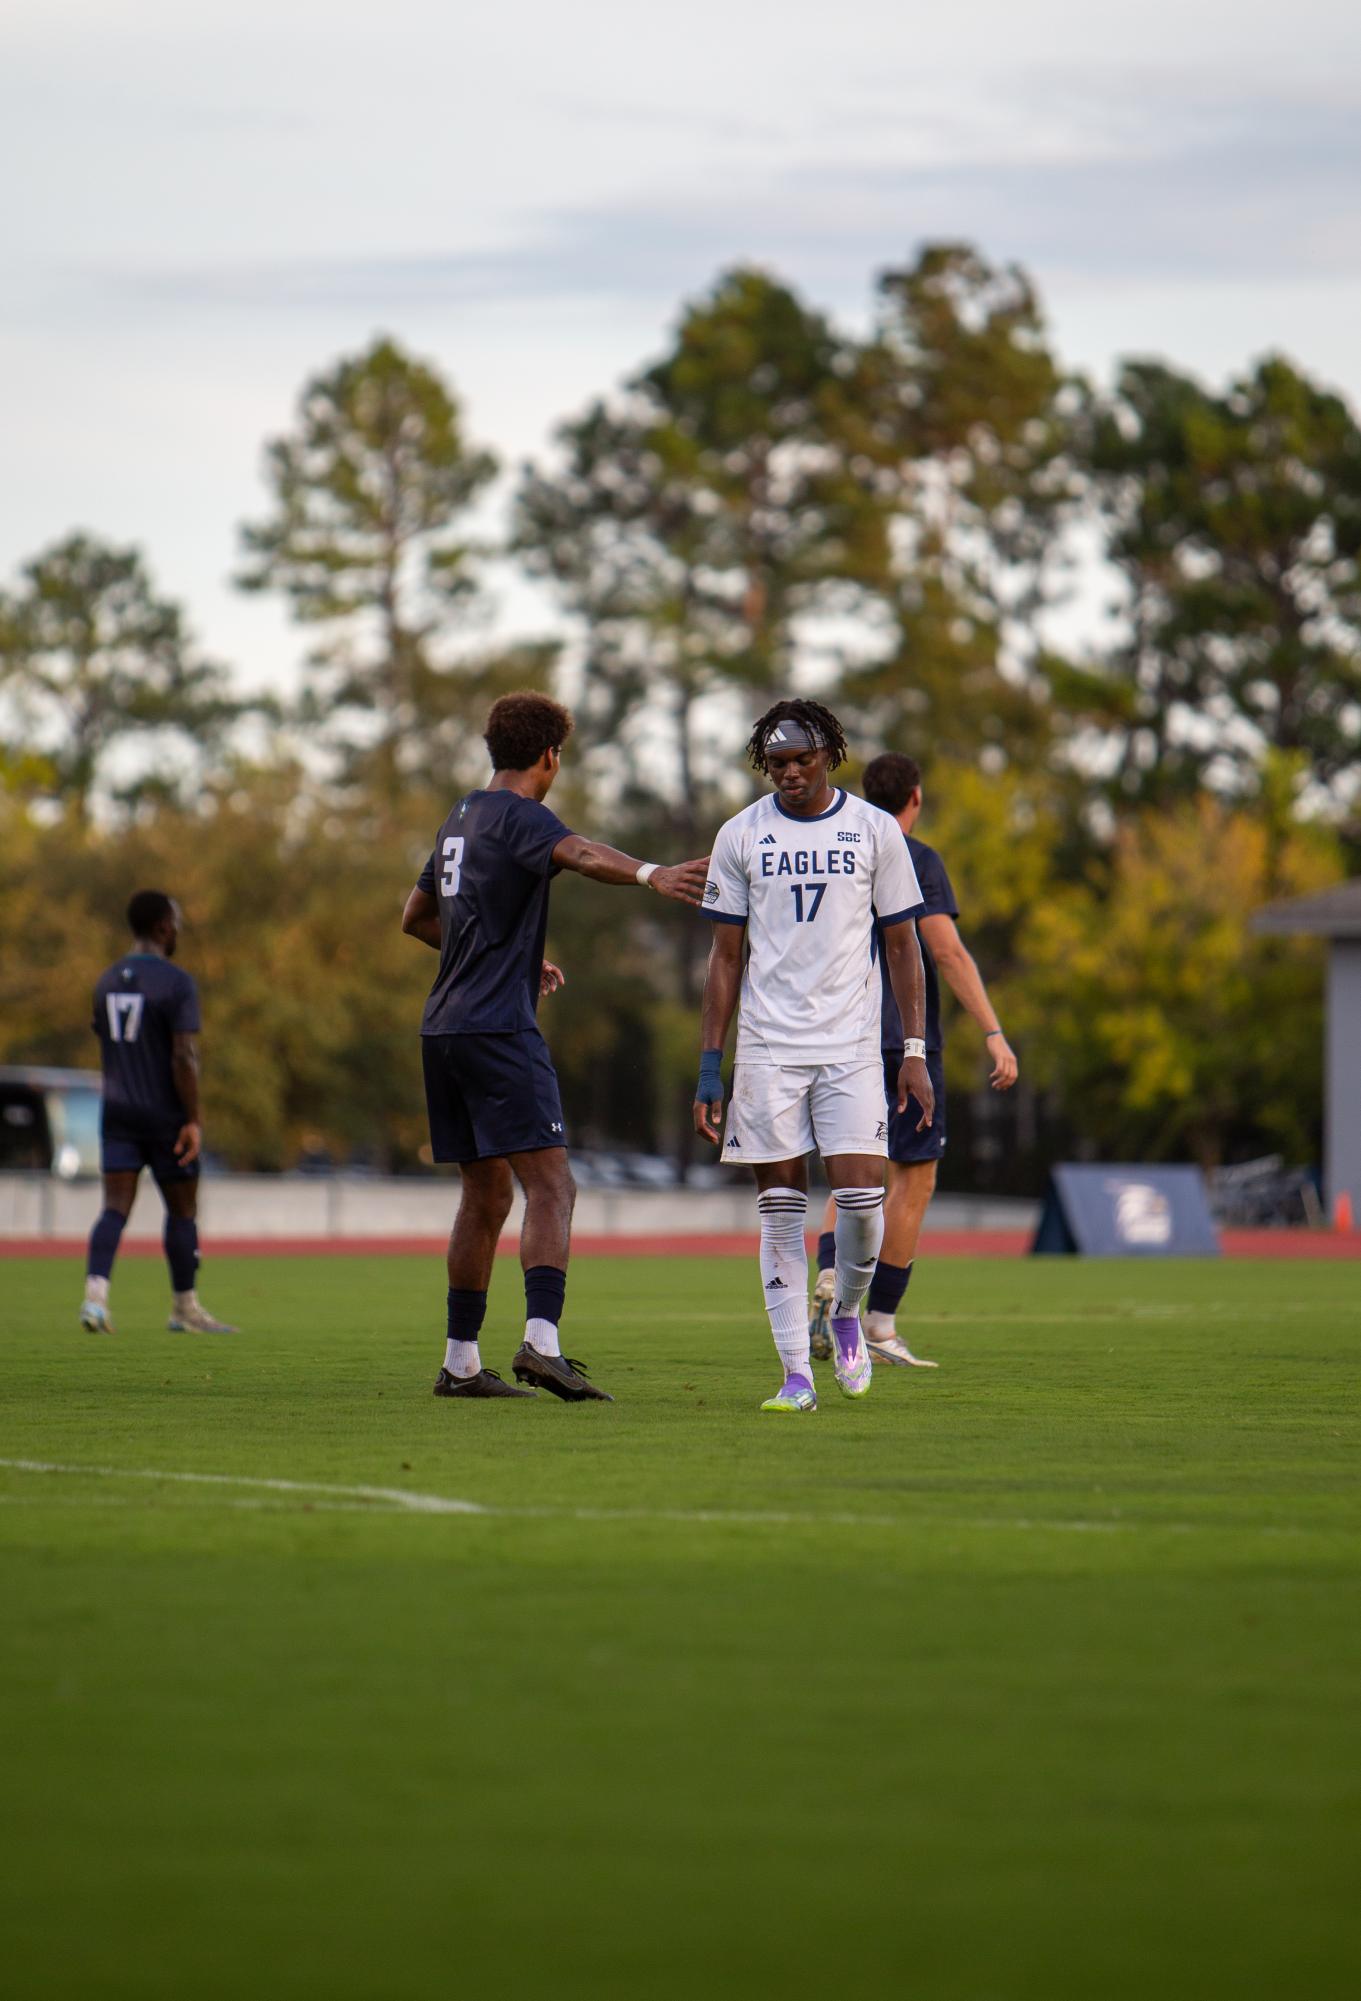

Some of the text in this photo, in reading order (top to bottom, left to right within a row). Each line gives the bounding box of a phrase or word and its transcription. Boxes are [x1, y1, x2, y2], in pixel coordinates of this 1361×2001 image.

[441, 836, 465, 897] 3
[761, 850, 856, 877] EAGLES
[790, 882, 828, 923] 17
[105, 992, 144, 1042] 17
